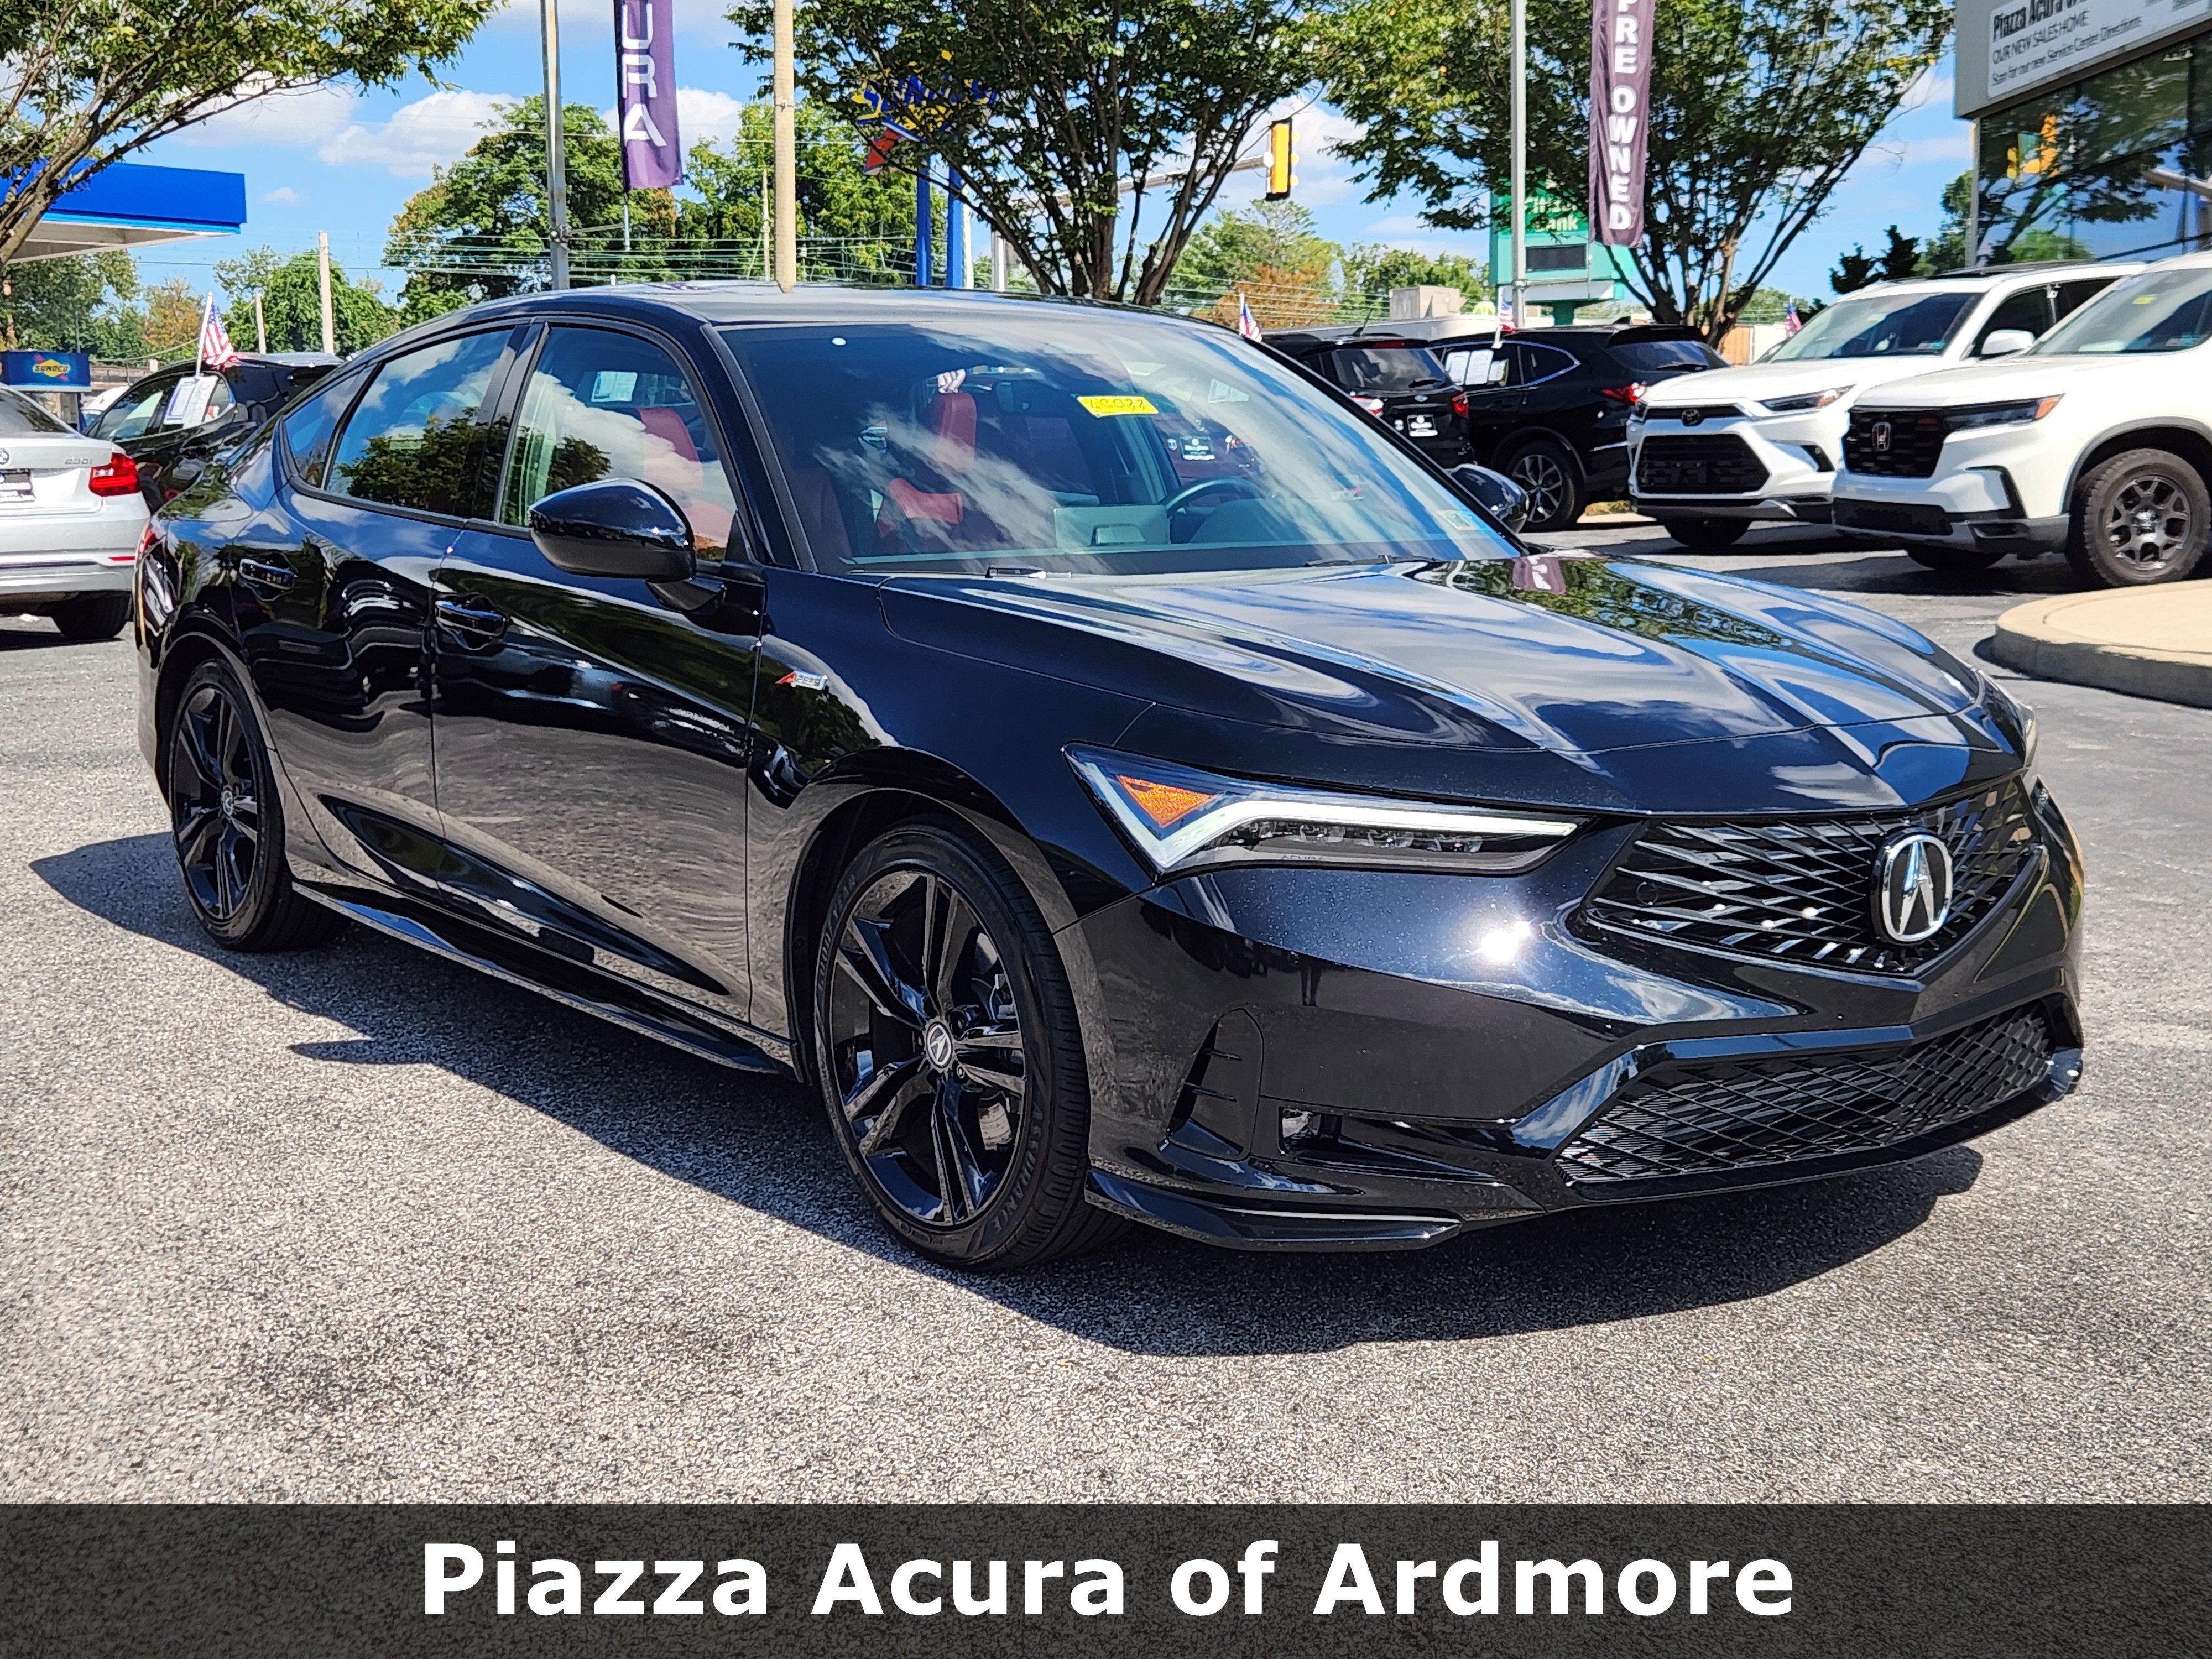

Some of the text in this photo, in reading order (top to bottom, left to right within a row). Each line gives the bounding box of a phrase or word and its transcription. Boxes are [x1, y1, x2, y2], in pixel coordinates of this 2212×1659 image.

[1993, 7, 2027, 43] Piazza
[1993, 9, 2090, 65] OUR NEW SALES HOME
[2047, 44, 2075, 63] Service
[1608, 85, 1638, 231] OWNED
[1534, 213, 1579, 233] ank
[34, 364, 69, 373] SUNOCO
